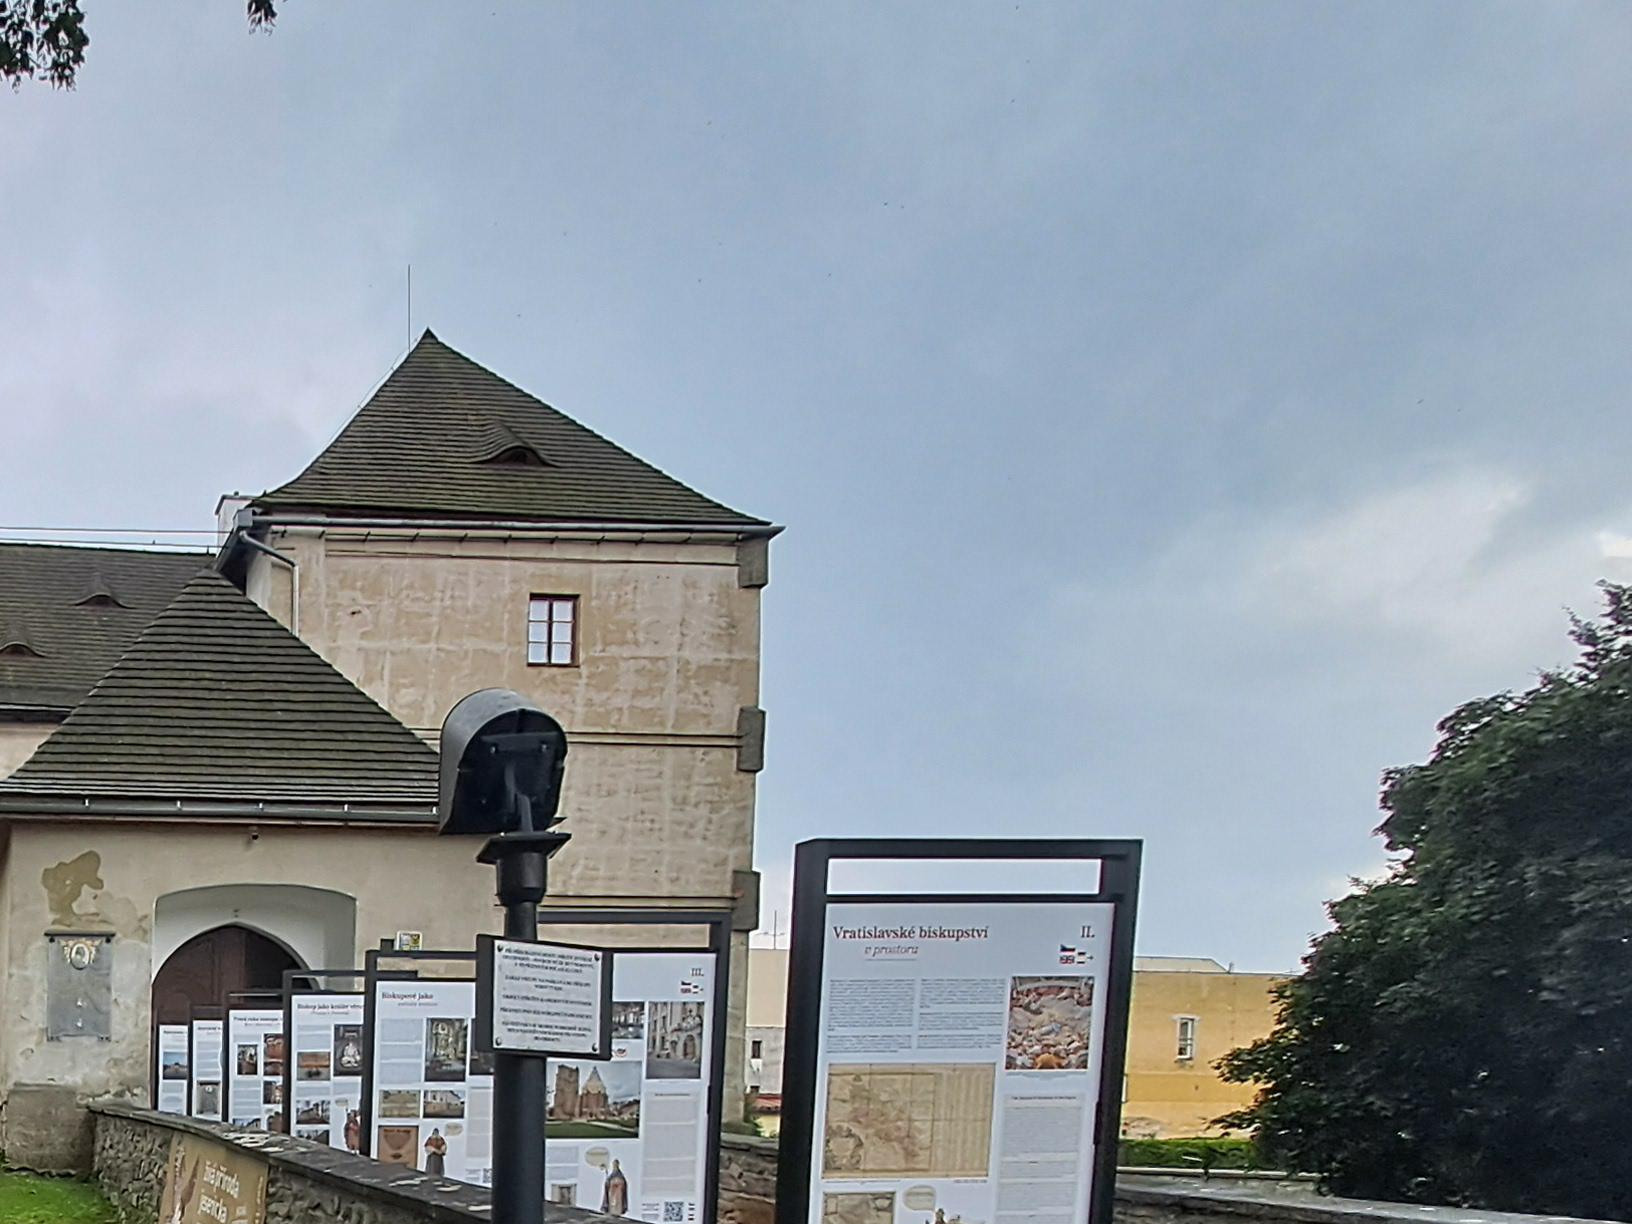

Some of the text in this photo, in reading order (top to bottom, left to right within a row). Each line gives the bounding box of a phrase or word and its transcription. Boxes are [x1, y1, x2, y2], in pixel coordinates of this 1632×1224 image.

[833, 925, 989, 942] Vratislavské biskupství
[1080, 925, 1096, 938] II.
[872, 945, 919, 957] prostoru
